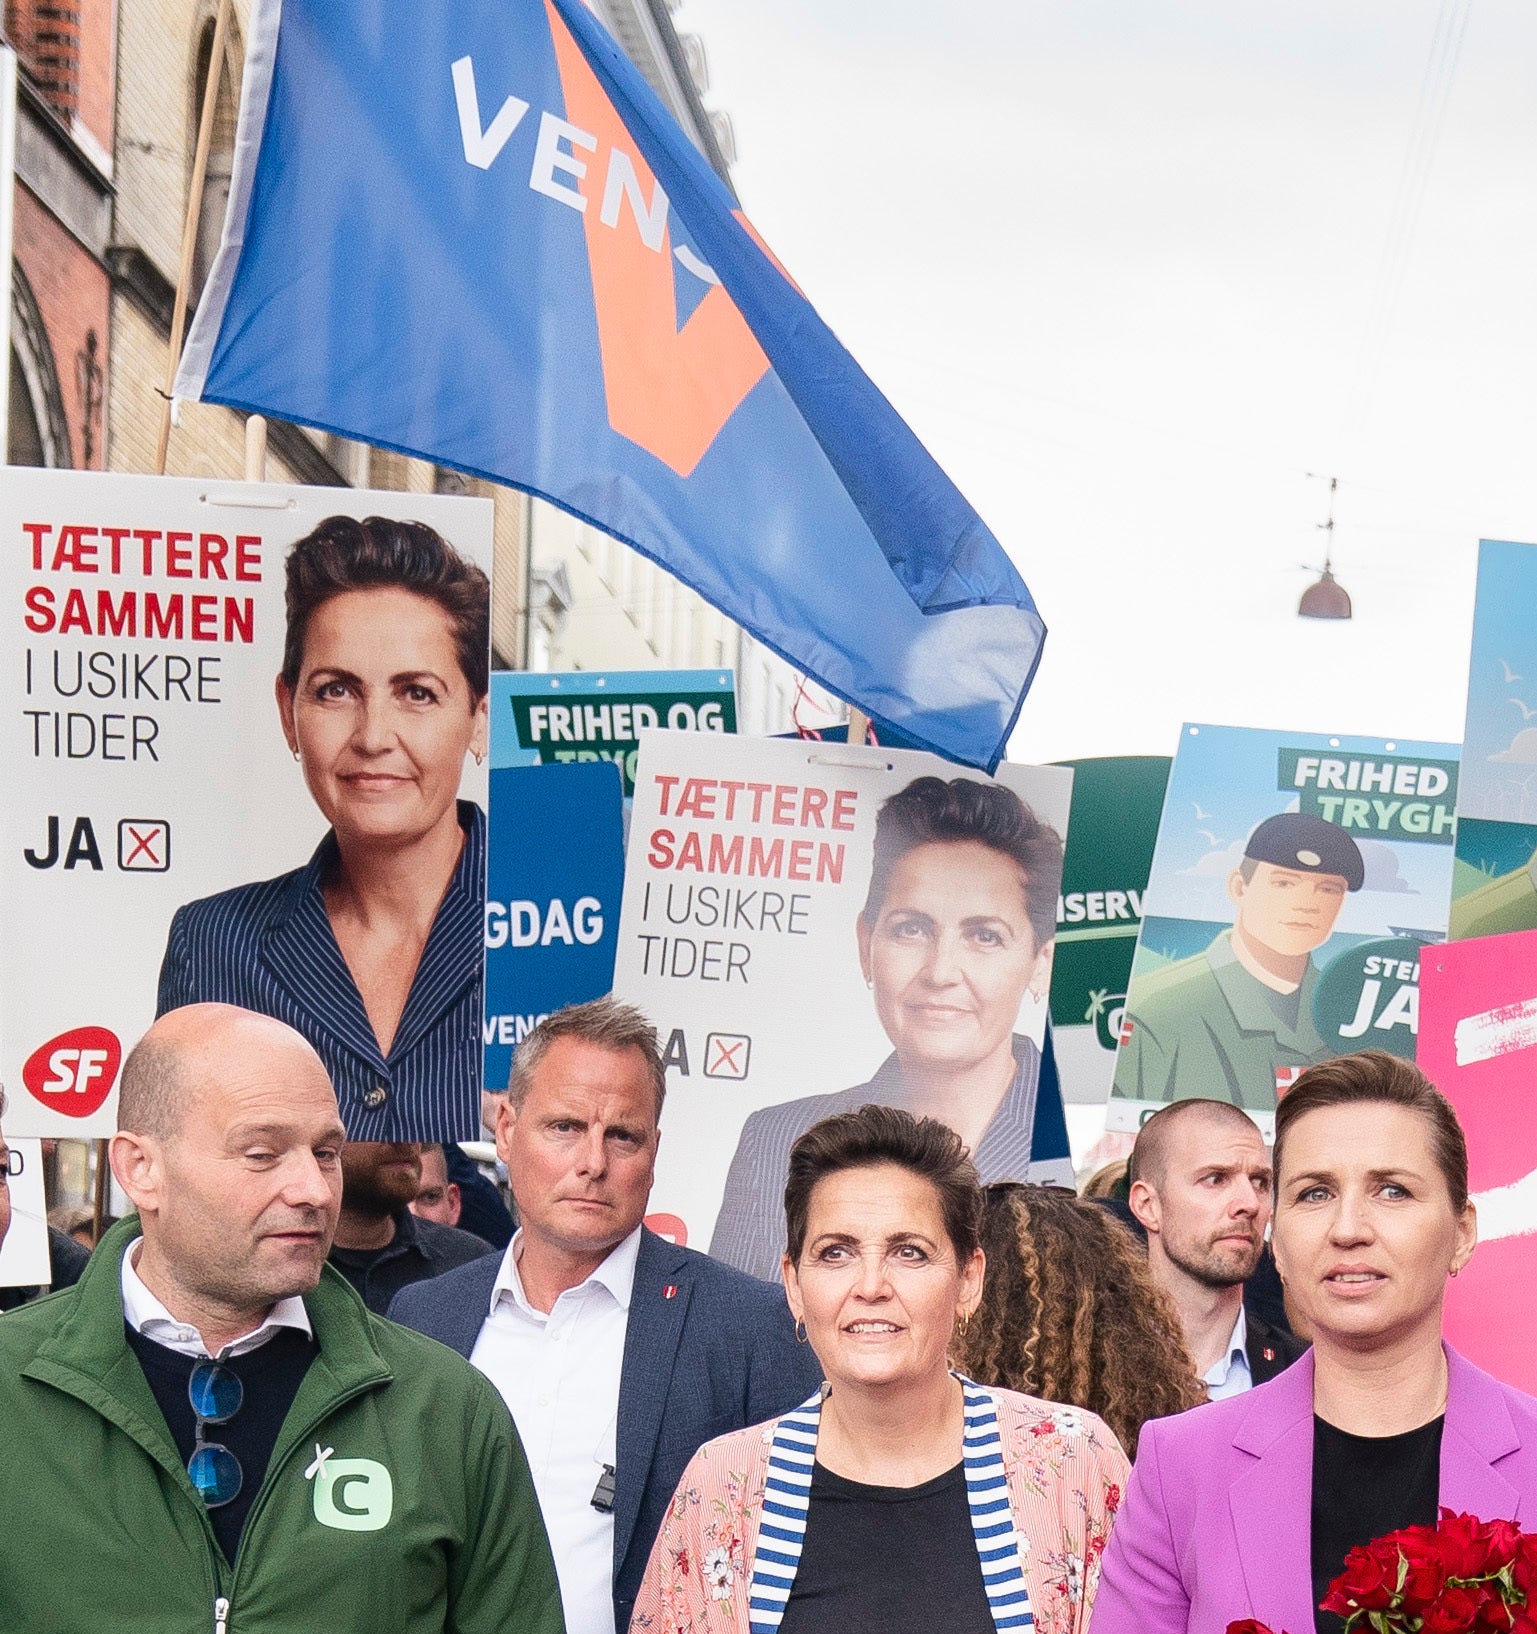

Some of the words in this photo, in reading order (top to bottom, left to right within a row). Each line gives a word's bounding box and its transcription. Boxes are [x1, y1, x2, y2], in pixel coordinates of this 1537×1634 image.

[22, 523, 263, 582] TÆTTERE
[23, 586, 255, 644] SAMMEN
[25, 651, 33, 696] I
[53, 650, 223, 704] USIKRE
[22, 710, 161, 762] TIDER
[529, 703, 659, 742] FRIHED
[653, 774, 858, 832] TÆTTERE
[1294, 757, 1449, 797] FRIHED
[23, 815, 104, 872] JA
[647, 829, 846, 884] SAMMEN
[643, 881, 651, 922] I
[666, 886, 811, 936] USIKRE
[637, 934, 751, 984] TIDER
[483, 1013, 548, 1046] VEN
[1338, 979, 1420, 1038] JA
[42, 1048, 107, 1096] SF
[660, 1028, 690, 1077] A
[331, 1473, 370, 1516] C
